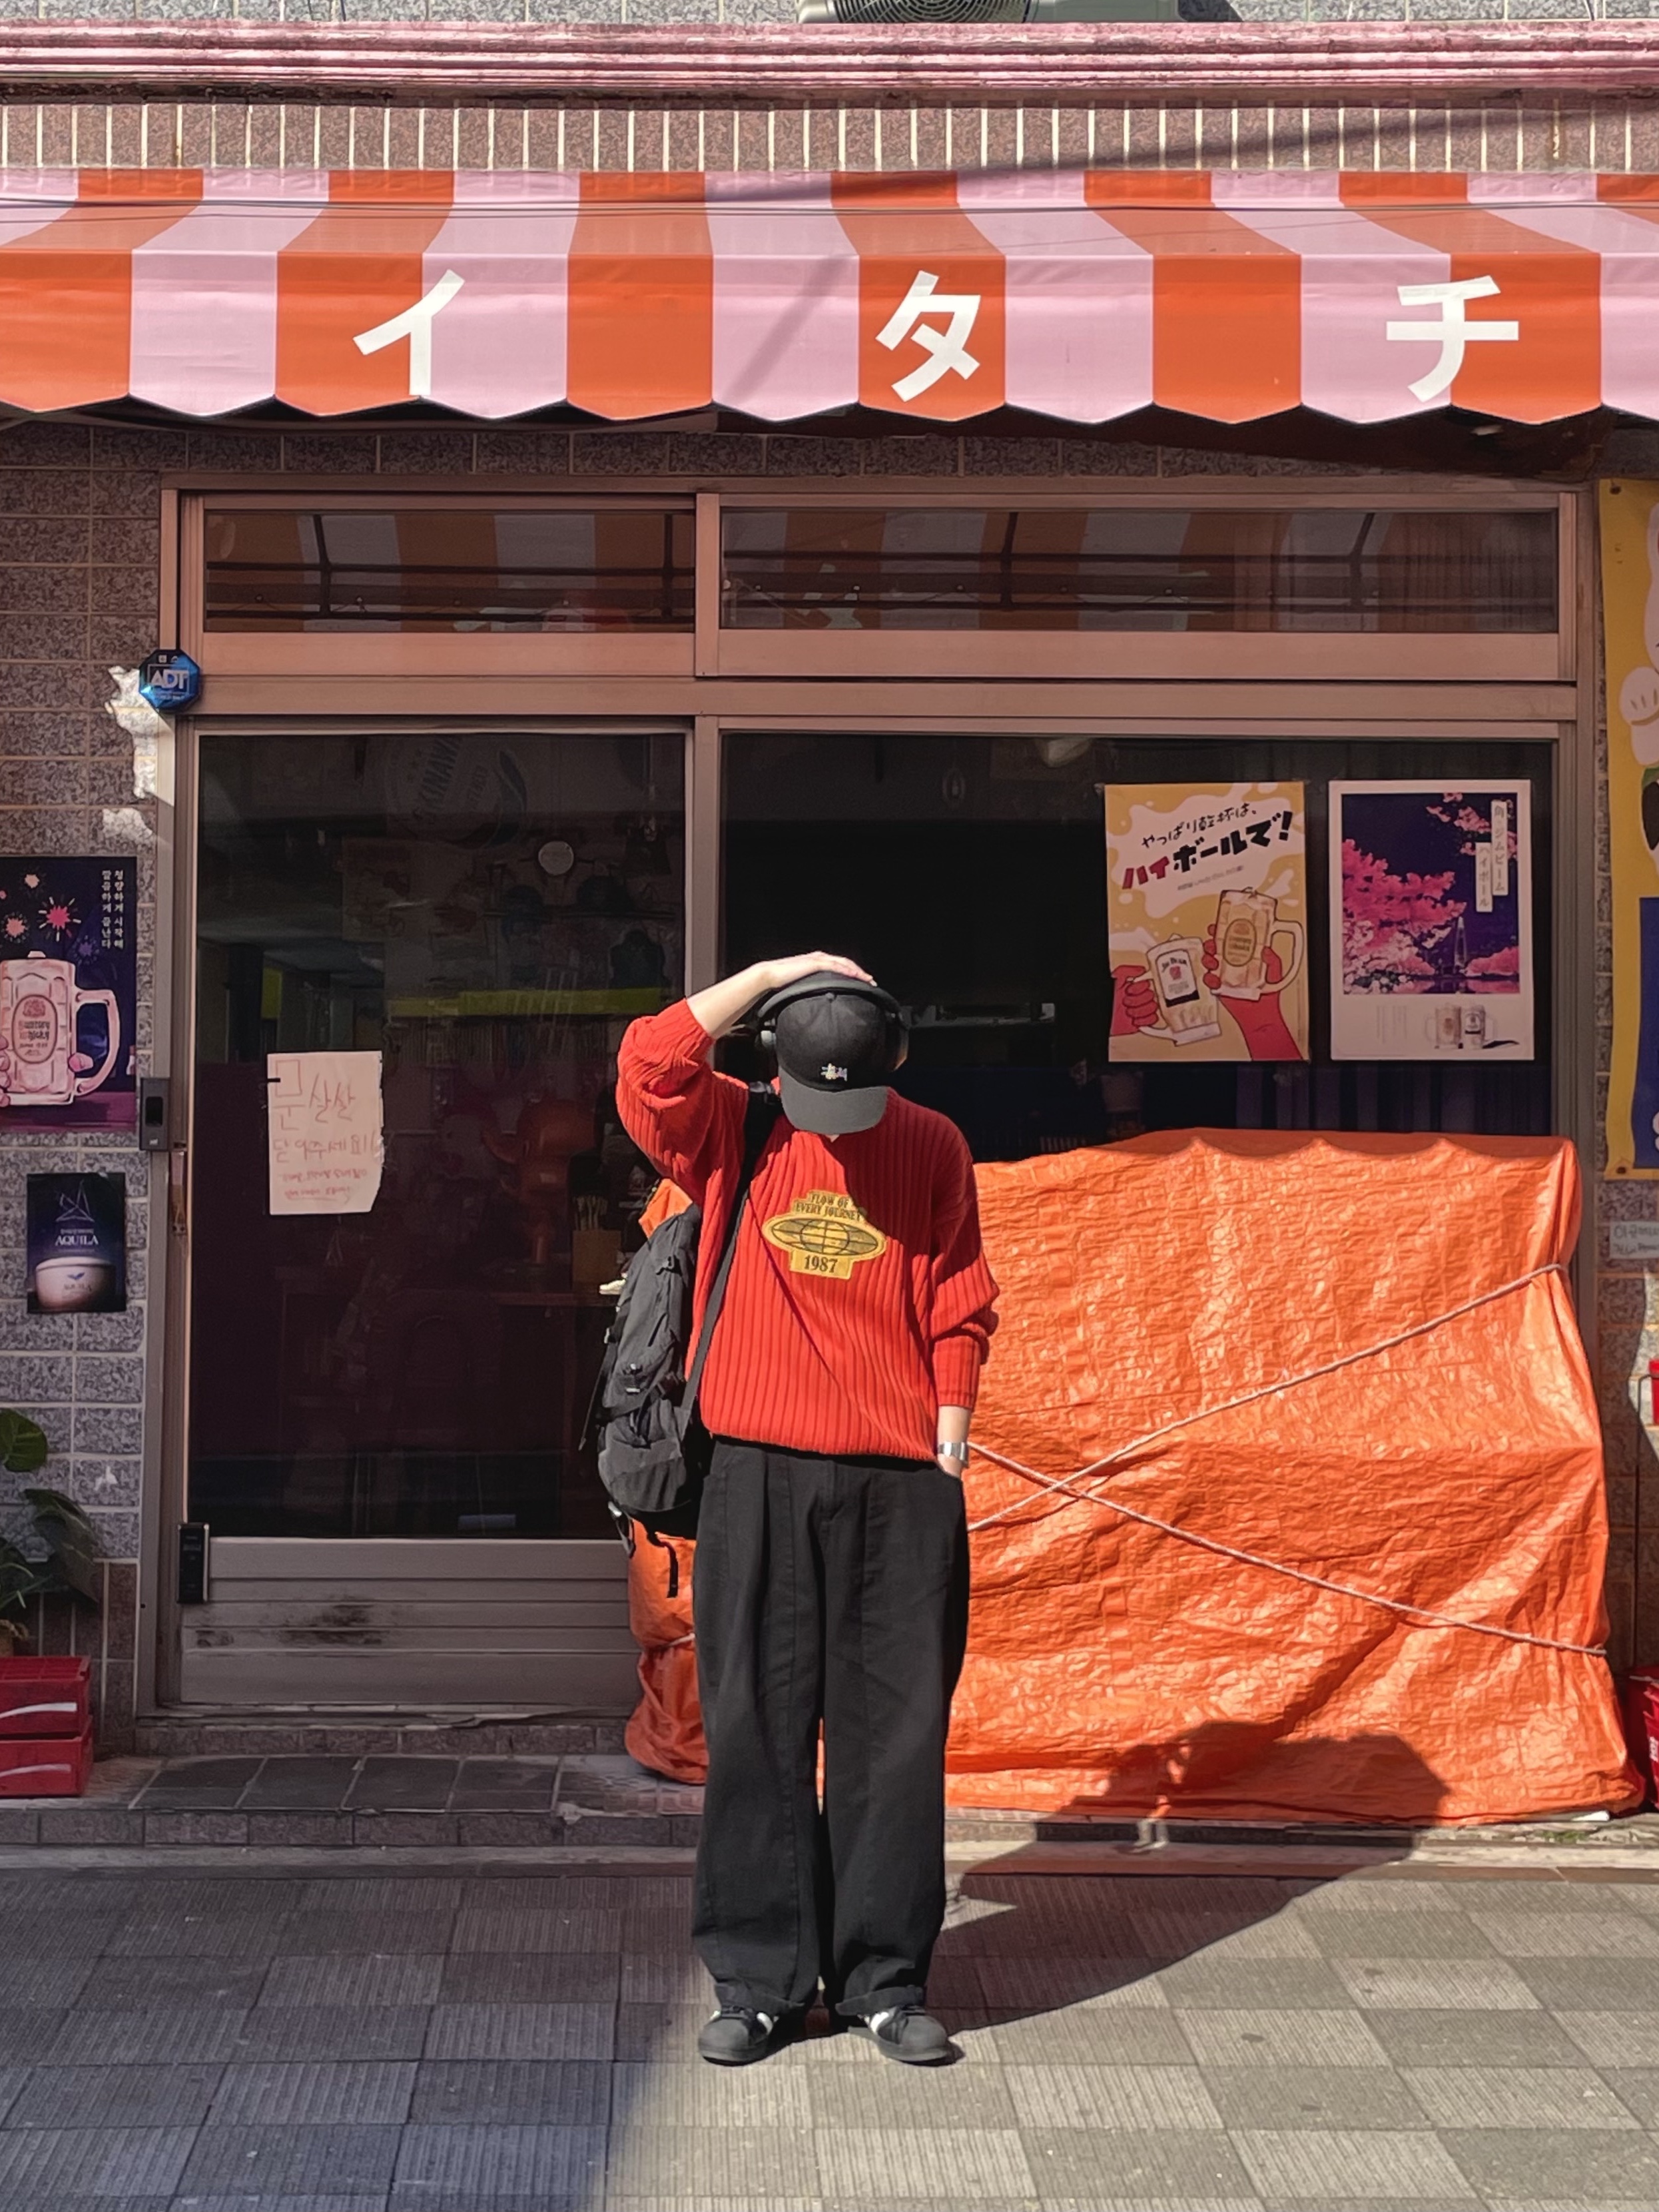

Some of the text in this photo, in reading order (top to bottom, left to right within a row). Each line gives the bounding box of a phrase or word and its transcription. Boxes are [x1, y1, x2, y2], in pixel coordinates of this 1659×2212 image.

[353, 269, 1519, 402] イタチ
[151, 669, 189, 689] ADT
[795, 1203, 822, 1215] EVERY
[811, 1194, 850, 1208] FLOW OF
[55, 1235, 99, 1246] AQUILA
[804, 1255, 838, 1274] 1987
